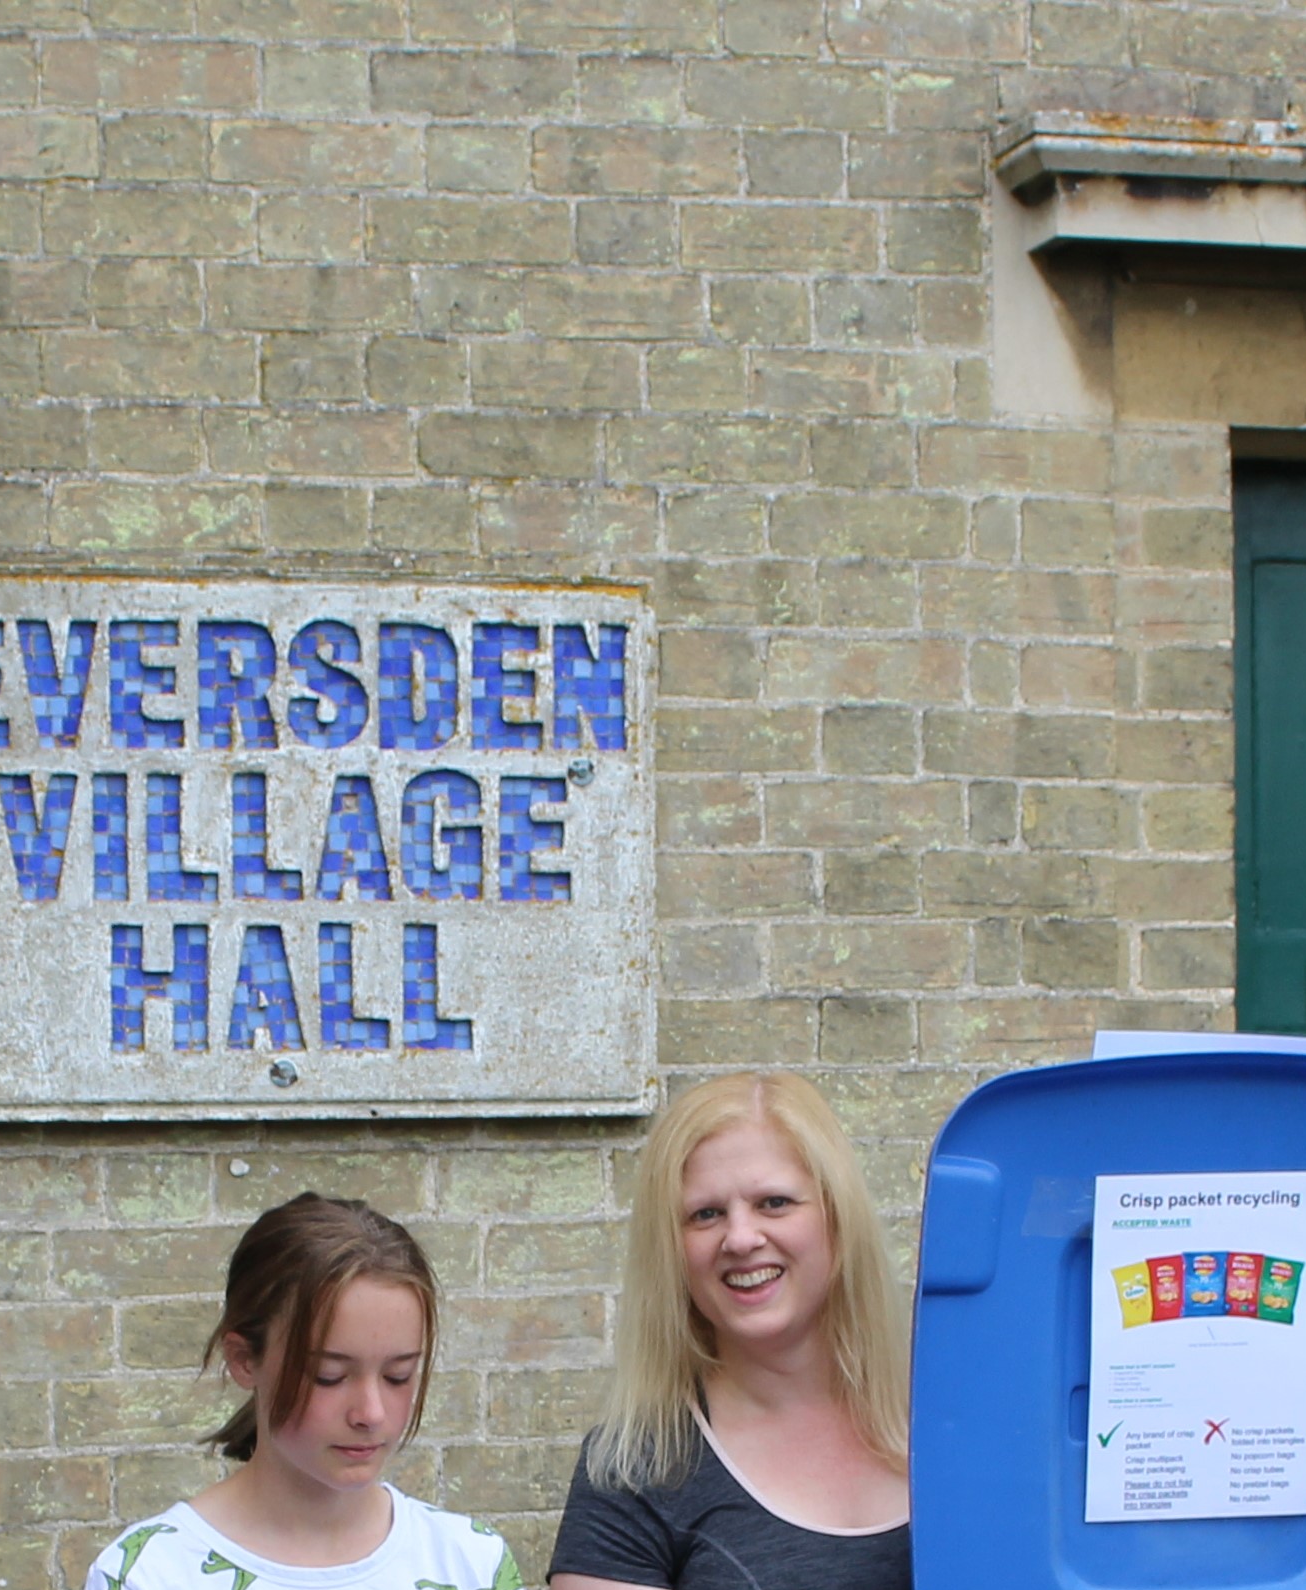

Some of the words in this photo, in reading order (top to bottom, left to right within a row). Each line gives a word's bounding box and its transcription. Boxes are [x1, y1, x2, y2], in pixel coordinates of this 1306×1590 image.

[109, 922, 475, 1052] HALL
[1120, 1193, 1163, 1209] Crisp
[1168, 1192, 1222, 1209] packet
[1227, 1190, 1300, 1208] recycling
[1112, 1219, 1157, 1227] ACCEPTED
[1161, 1218, 1191, 1227] WASTE
